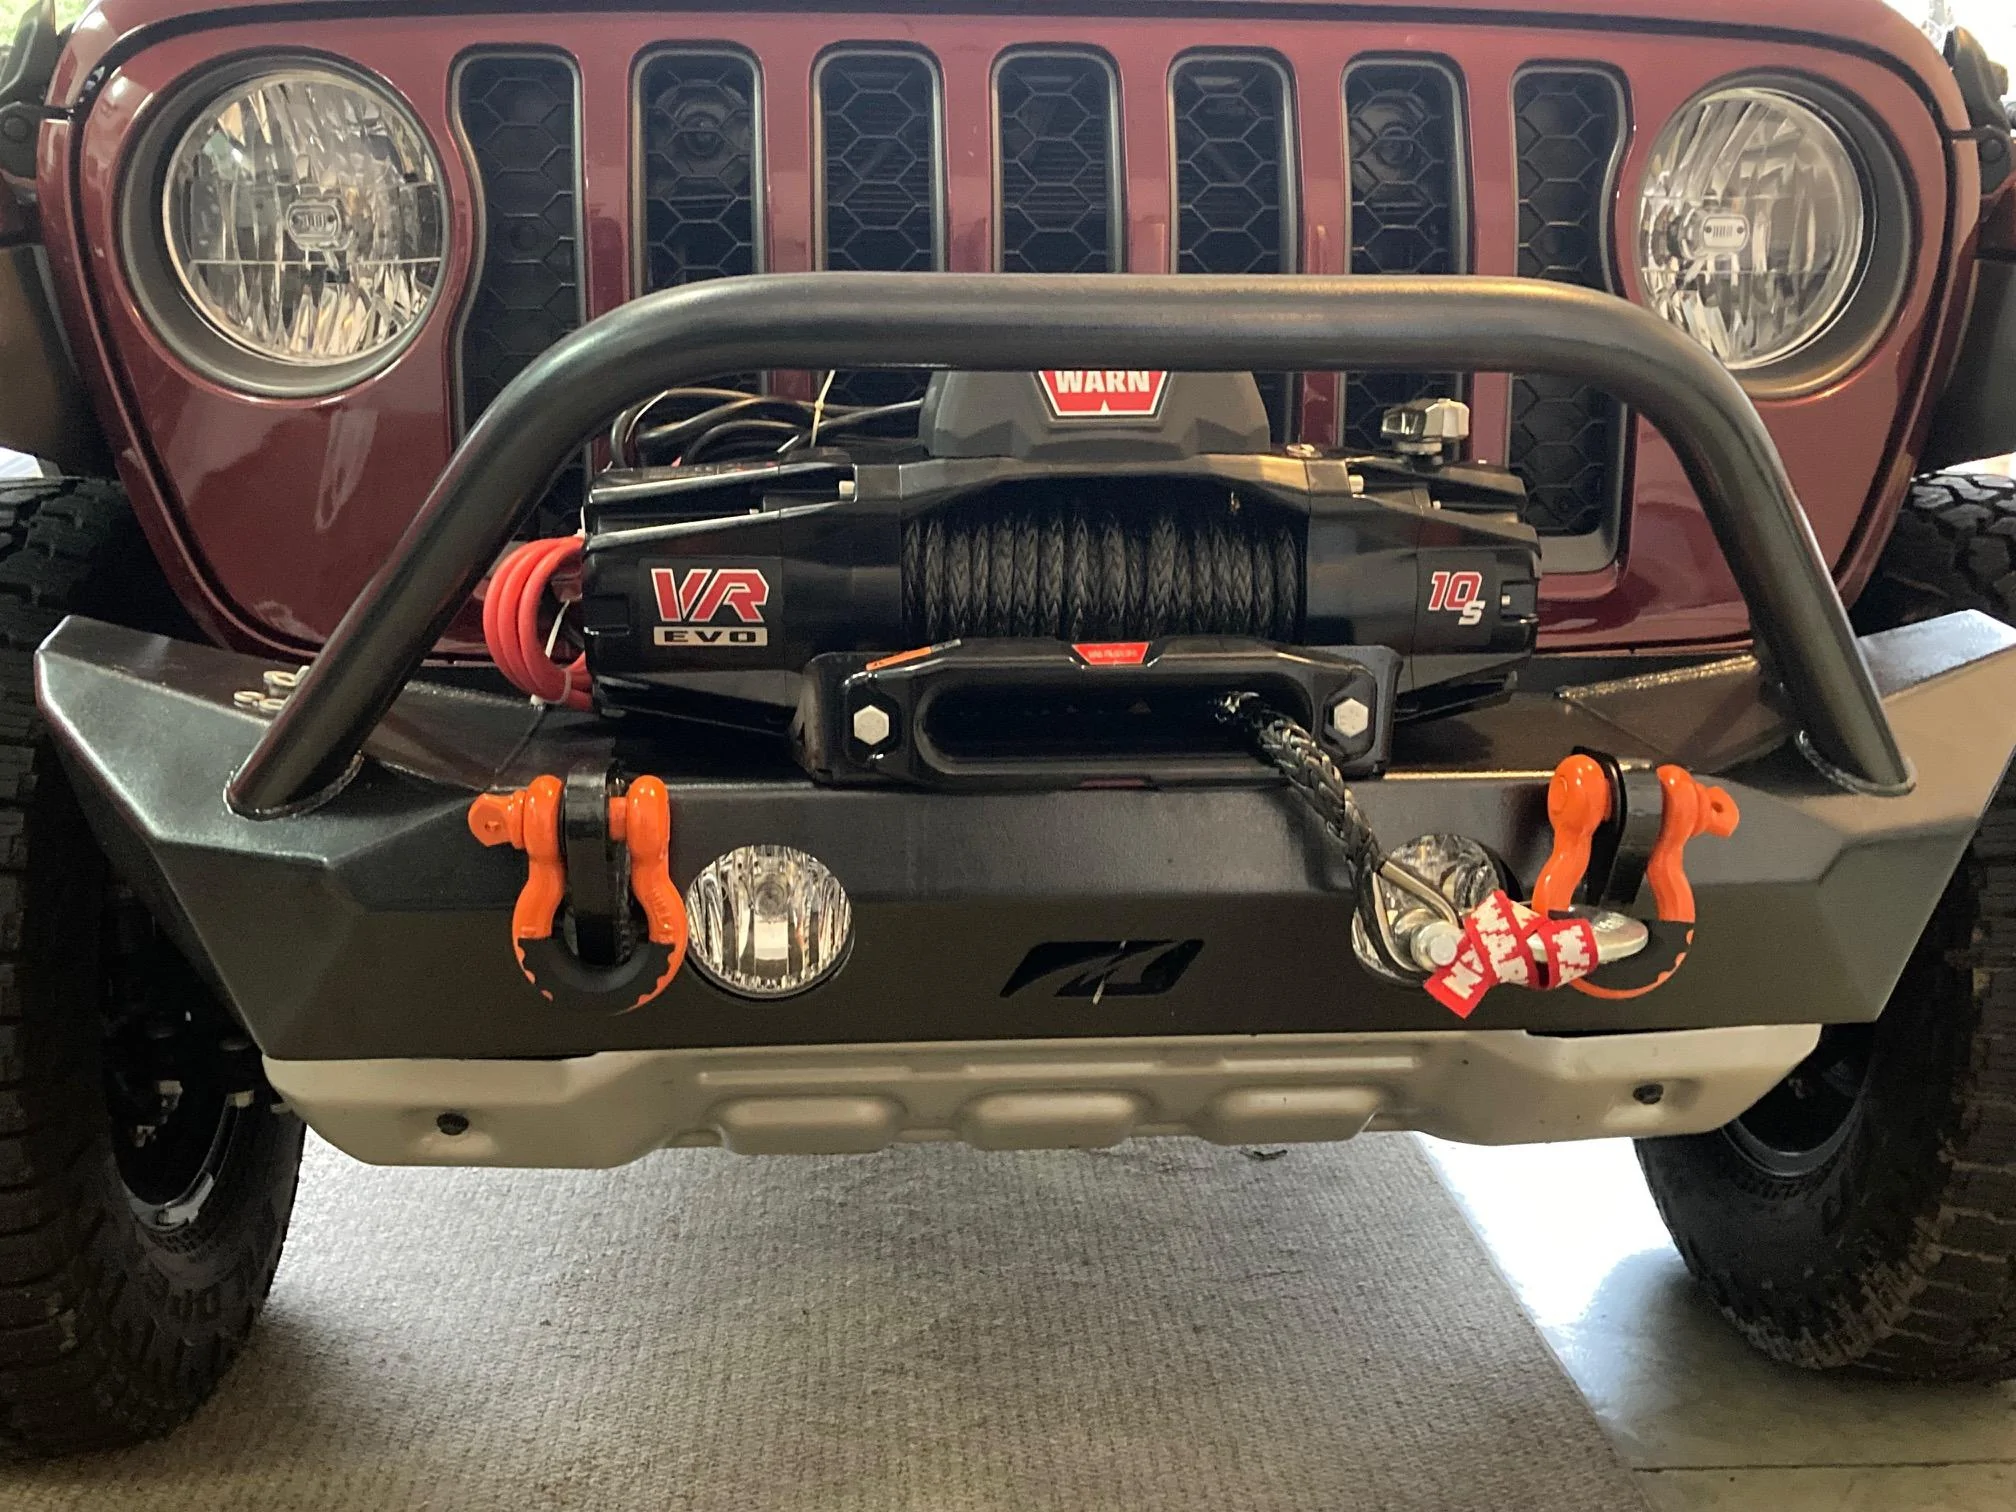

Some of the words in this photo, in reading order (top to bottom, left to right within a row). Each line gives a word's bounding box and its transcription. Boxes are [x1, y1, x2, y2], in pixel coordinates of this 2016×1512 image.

[1055, 370, 1150, 393] WARN
[651, 568, 769, 622] VR
[1428, 571, 1482, 611] 10
[662, 629, 758, 644] EVO
[1470, 895, 1530, 984] WAR
